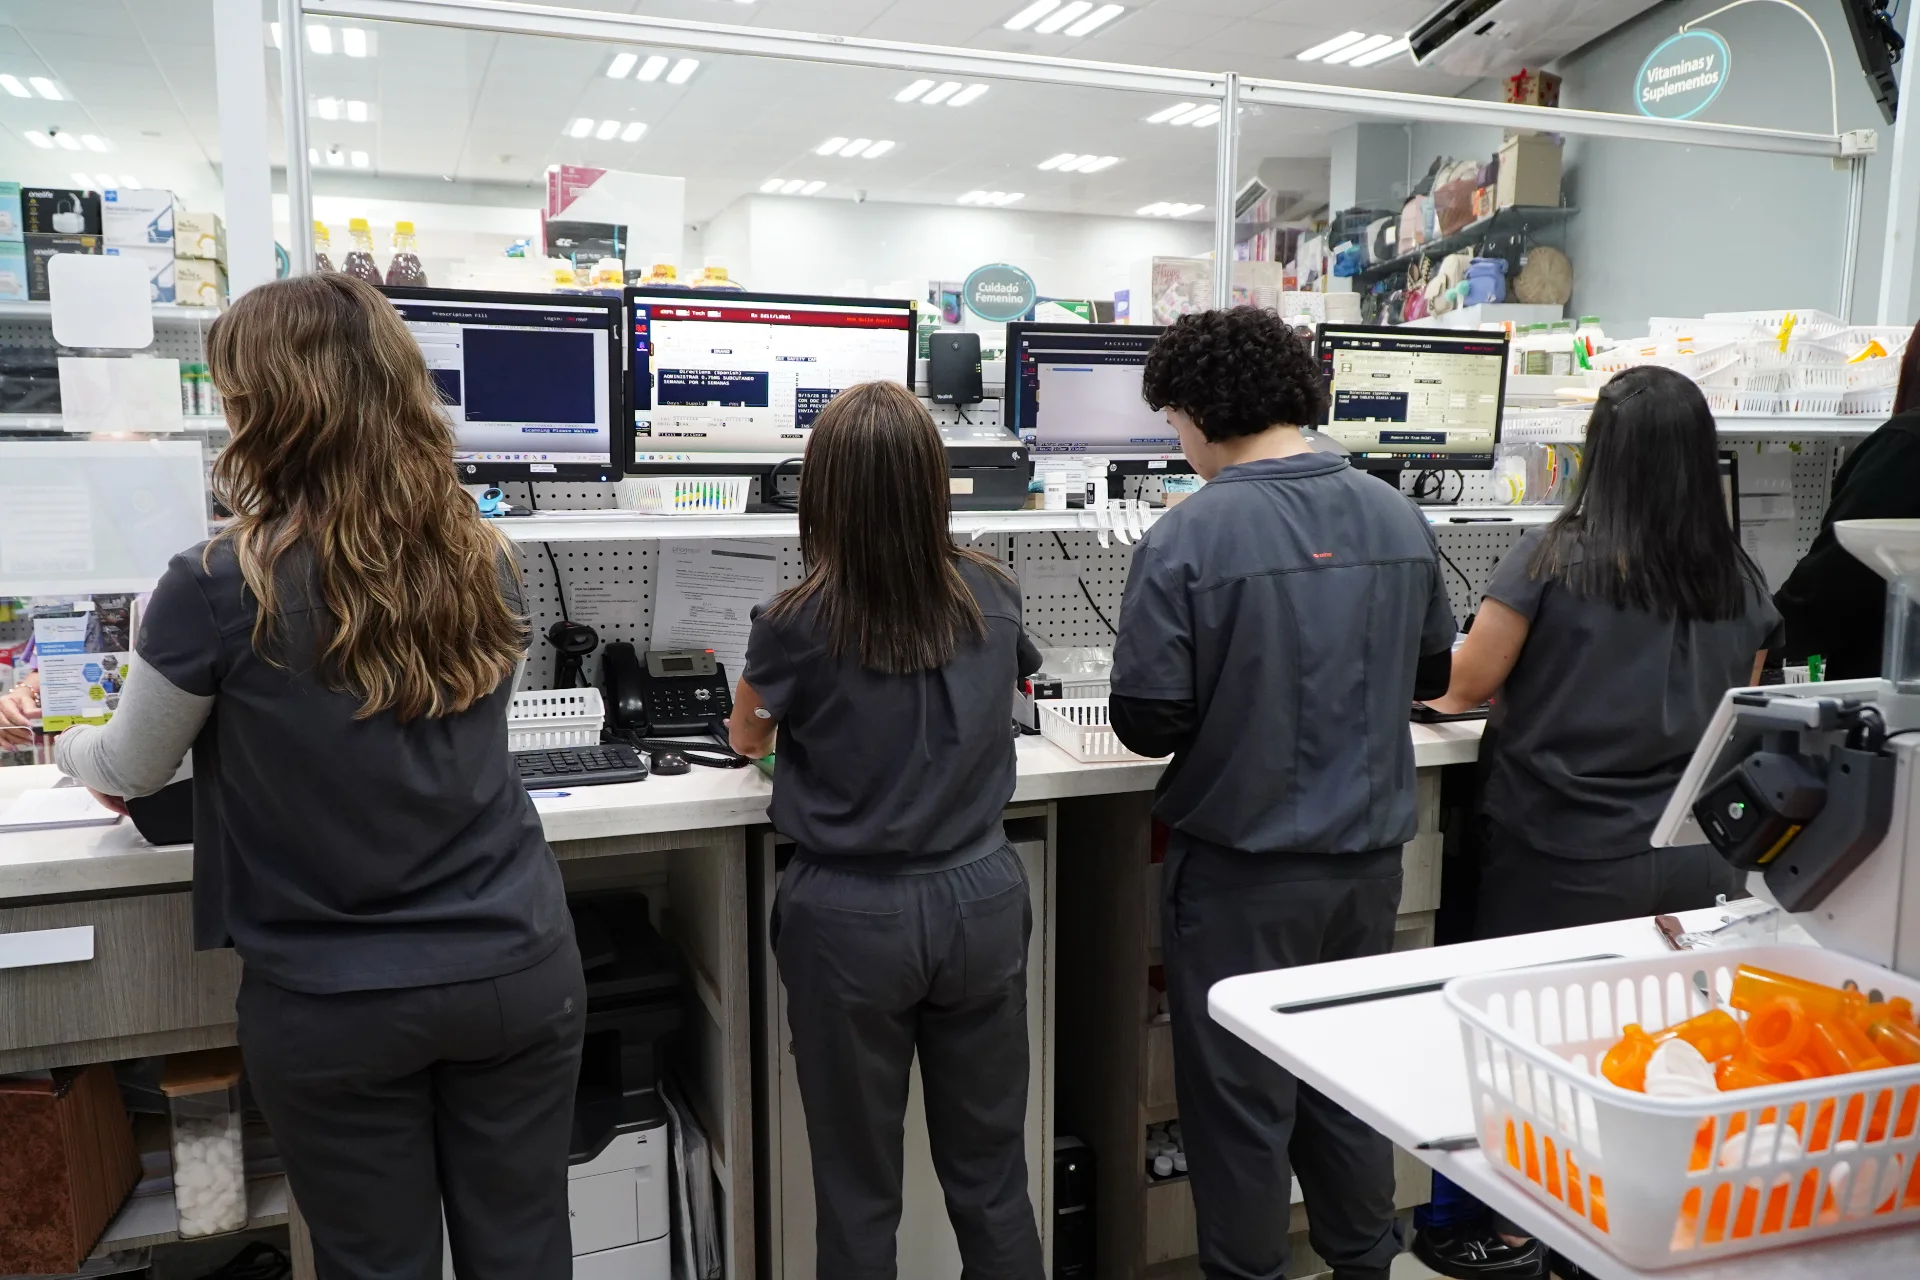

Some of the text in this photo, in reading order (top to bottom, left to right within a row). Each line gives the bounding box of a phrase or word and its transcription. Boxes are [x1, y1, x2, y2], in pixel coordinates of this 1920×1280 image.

[1647, 54, 1715, 83] Vitaminas y
[1642, 71, 1719, 102] Suplementos
[975, 293, 1024, 304] Femenino
